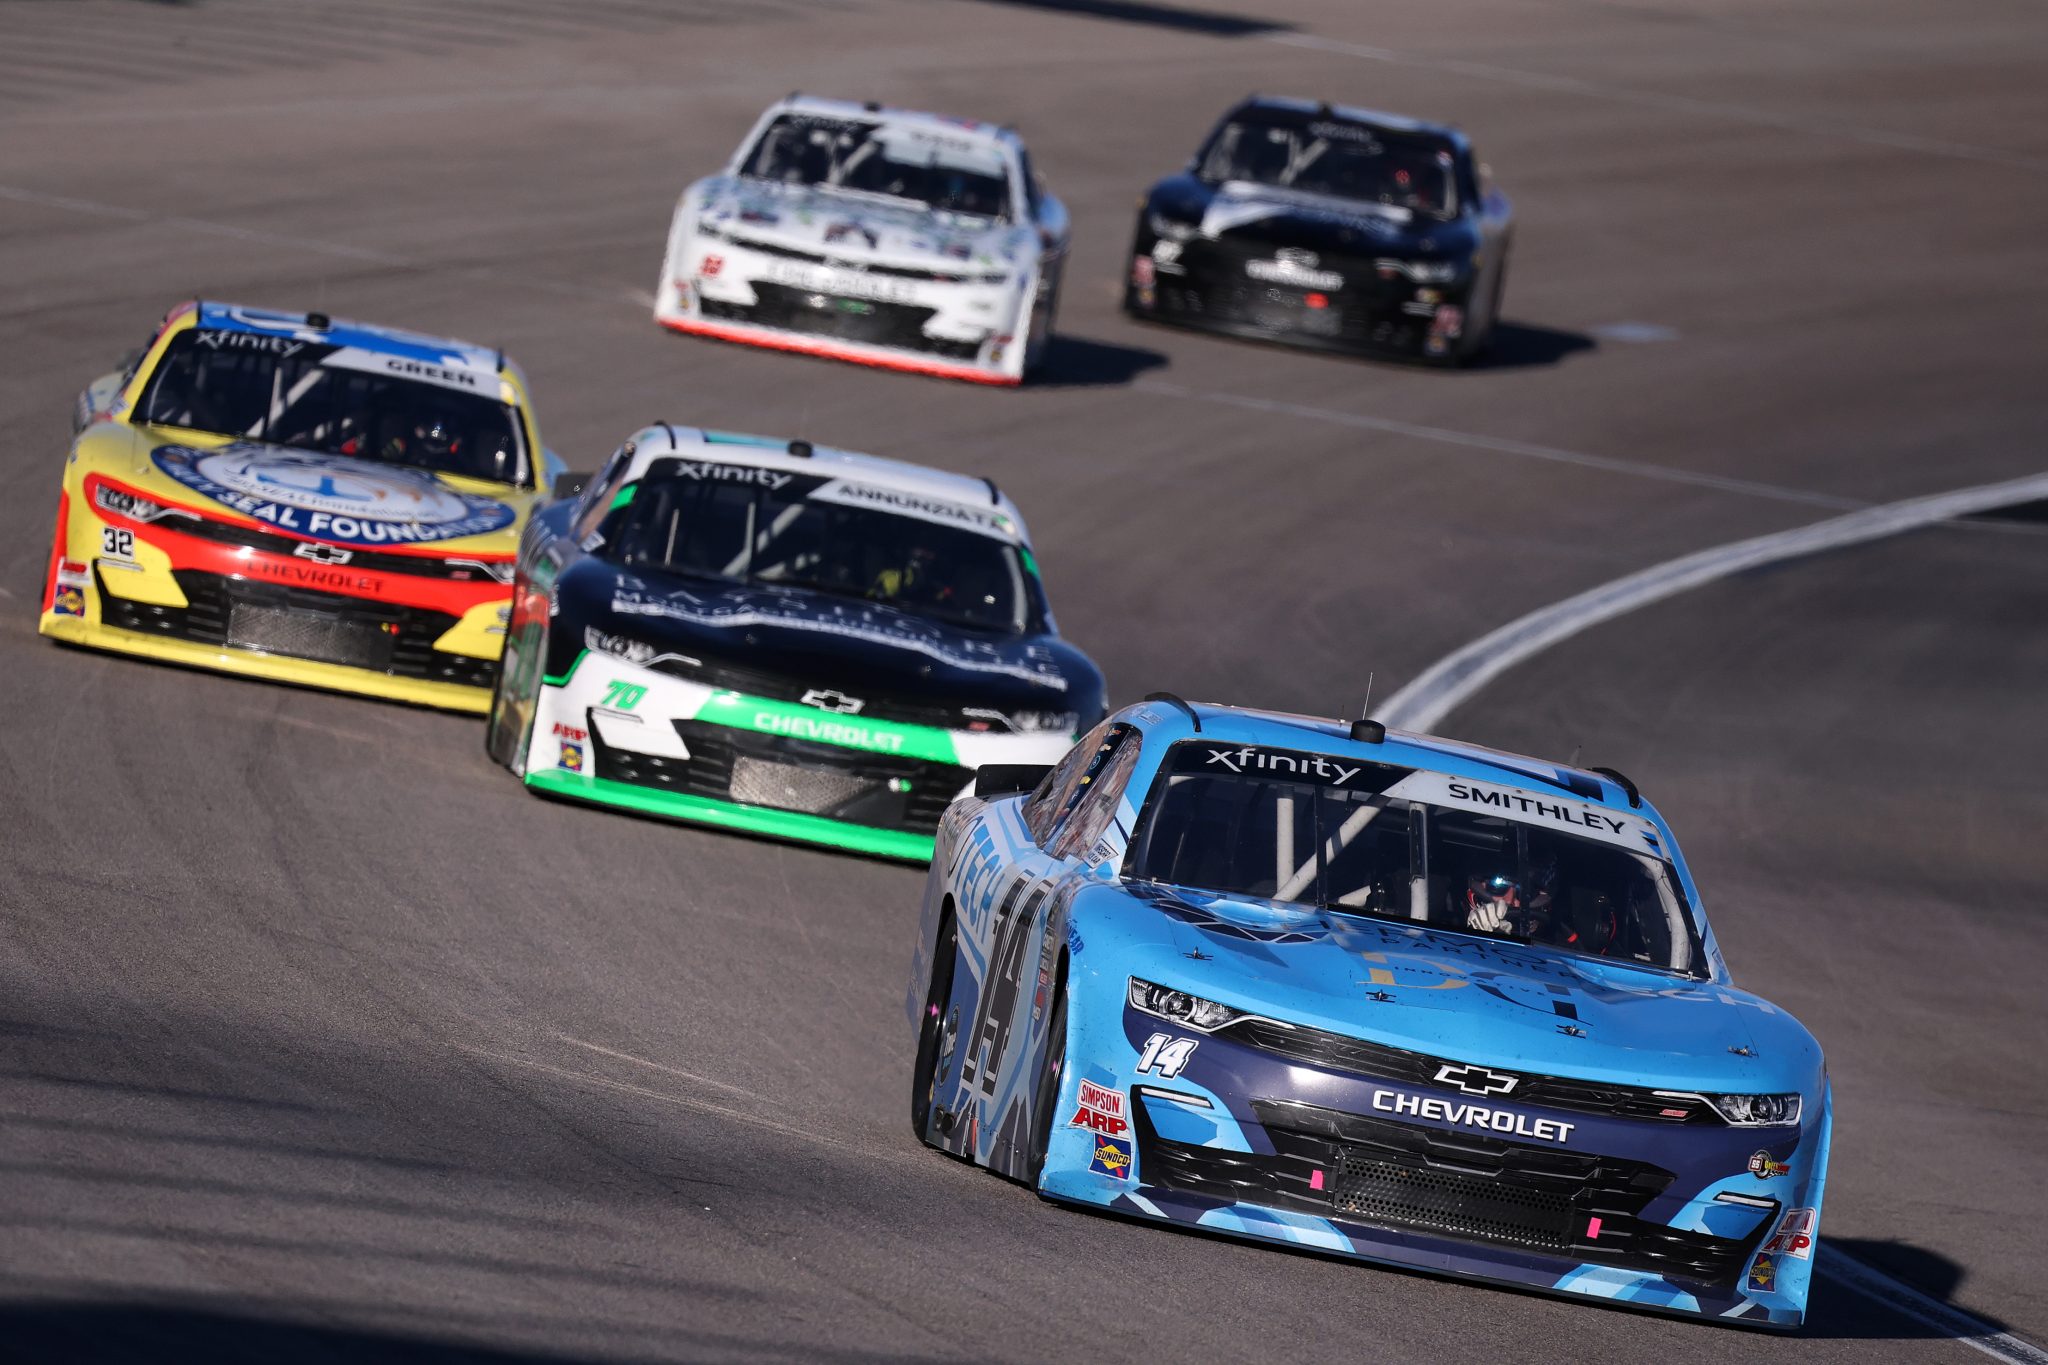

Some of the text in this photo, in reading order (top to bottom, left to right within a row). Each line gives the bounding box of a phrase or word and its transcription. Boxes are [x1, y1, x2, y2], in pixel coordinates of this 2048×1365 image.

[195, 330, 304, 358] xfinity
[387, 359, 476, 386] GREEN
[676, 461, 793, 489] xfinity
[104, 527, 132, 557] 32
[247, 559, 384, 594] CHEVROLET
[601, 679, 648, 709] 70
[754, 702, 904, 752] CHEVROLET
[1206, 748, 1361, 785] xfinity
[1448, 784, 1625, 834] SMITHLEY
[1136, 1033, 1199, 1080] 14
[1081, 1084, 1121, 1114] SIMPSON
[1072, 1107, 1128, 1135] ARP
[1372, 1090, 1575, 1143] CHEVROLET
[1096, 1149, 1129, 1166] SUNOCO
[1763, 1235, 1811, 1253] AP
